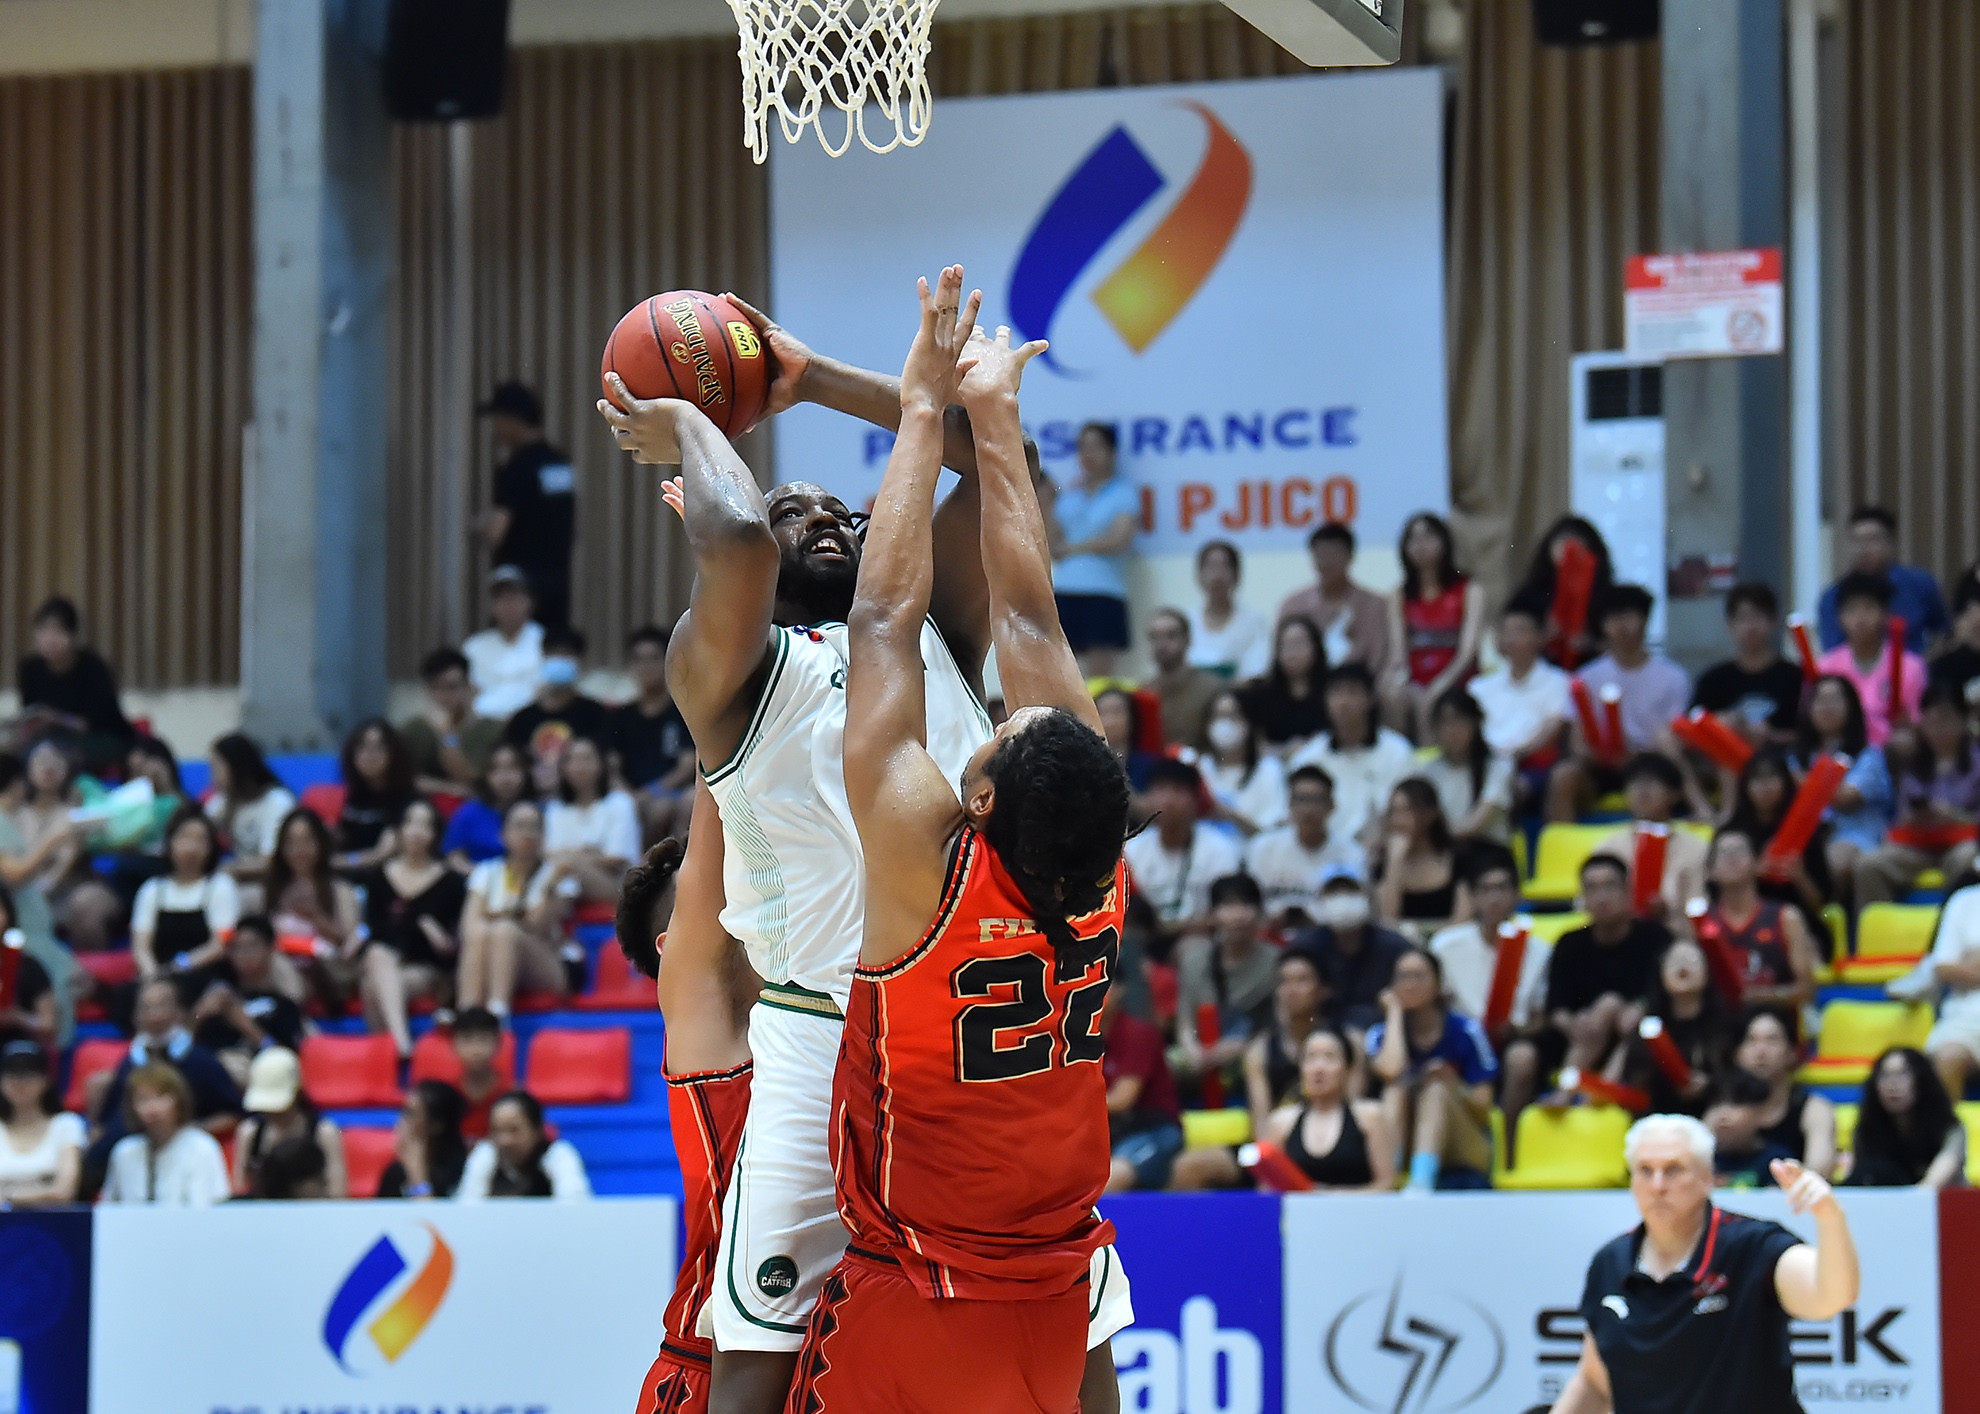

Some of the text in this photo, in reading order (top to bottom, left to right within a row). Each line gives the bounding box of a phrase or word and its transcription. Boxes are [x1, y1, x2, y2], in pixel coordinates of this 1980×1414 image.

[663, 298, 726, 408] SPALDING
[734, 326, 750, 351] VBA
[1024, 406, 1358, 460] SRANCE
[1179, 475, 1358, 533] PJICO
[950, 923, 1120, 1083] 22
[761, 1276, 792, 1288] CATFISH
[1110, 1294, 1265, 1414] ab
